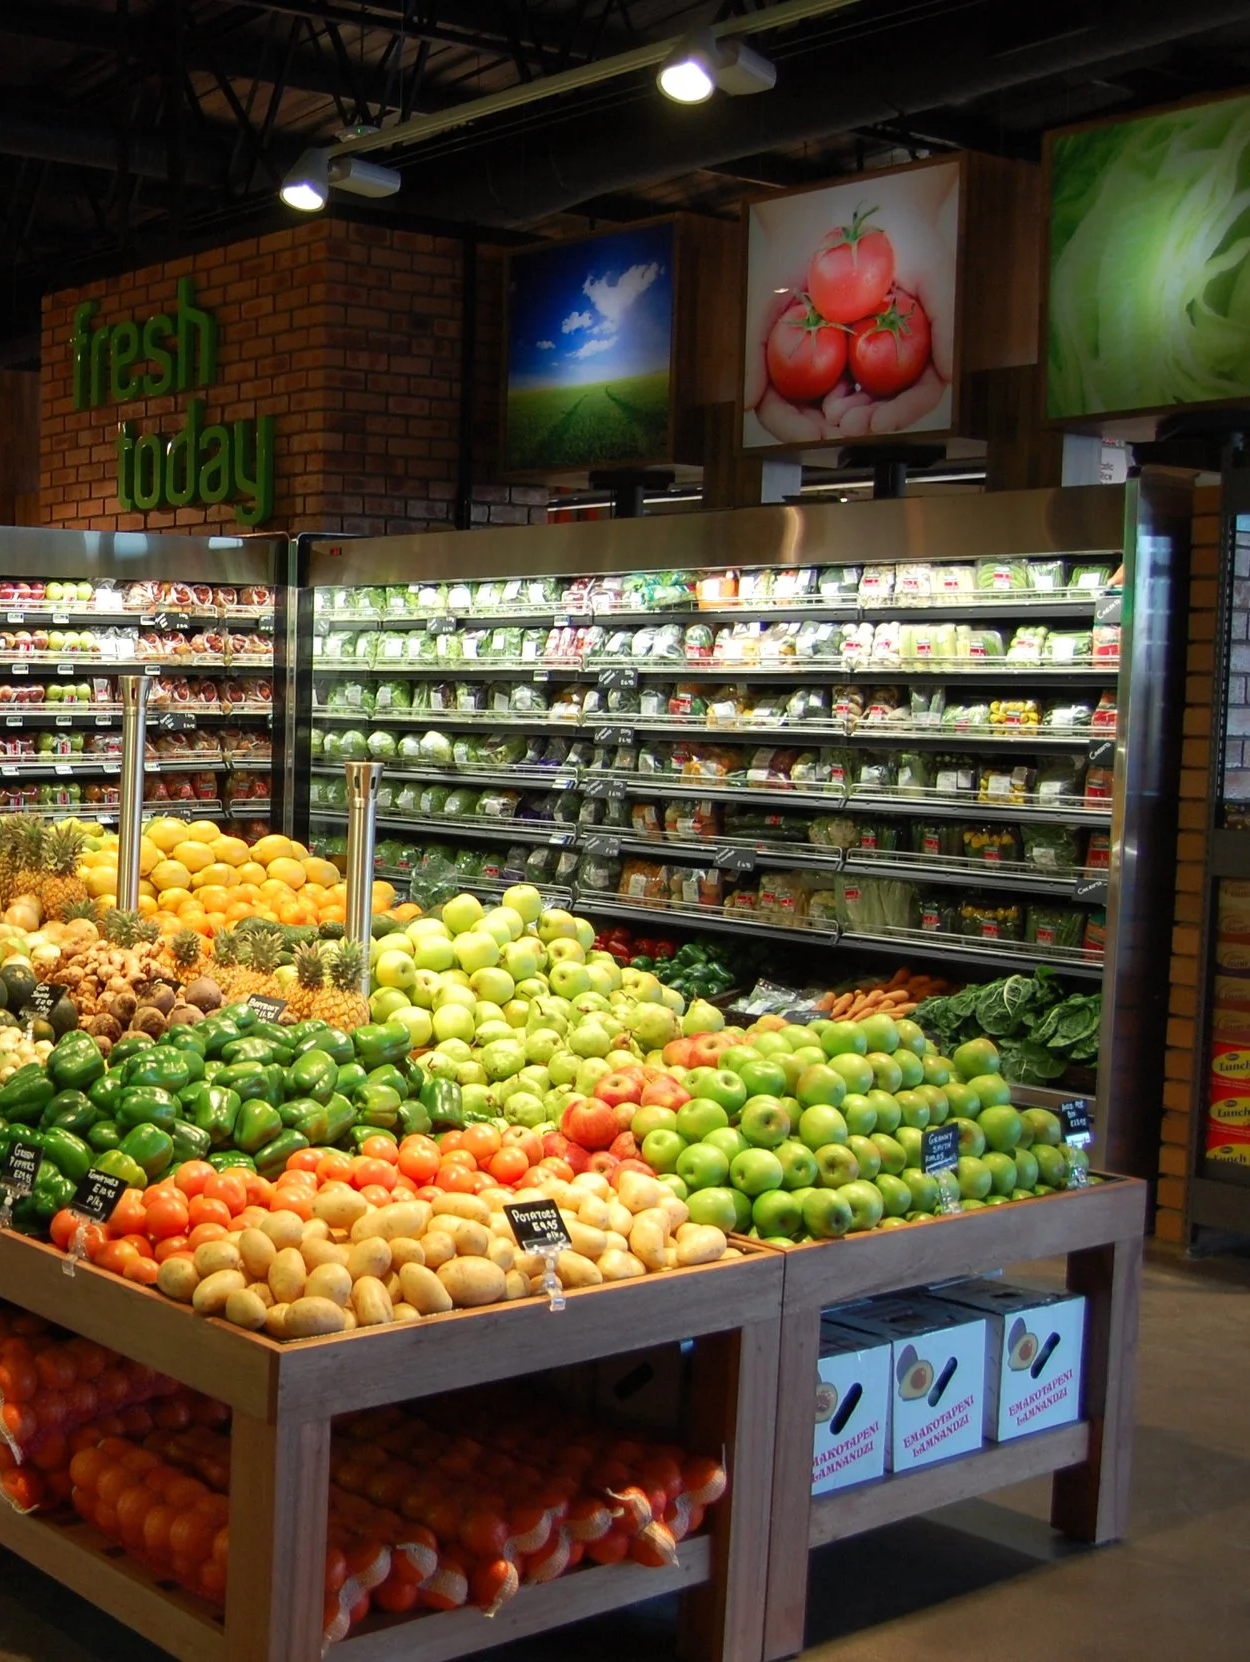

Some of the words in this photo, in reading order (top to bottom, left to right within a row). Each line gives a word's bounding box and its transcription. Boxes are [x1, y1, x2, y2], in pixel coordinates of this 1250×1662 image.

[70, 276, 219, 410] fresh
[117, 398, 274, 527] today
[813, 1420, 880, 1467] MAKOTAPENI
